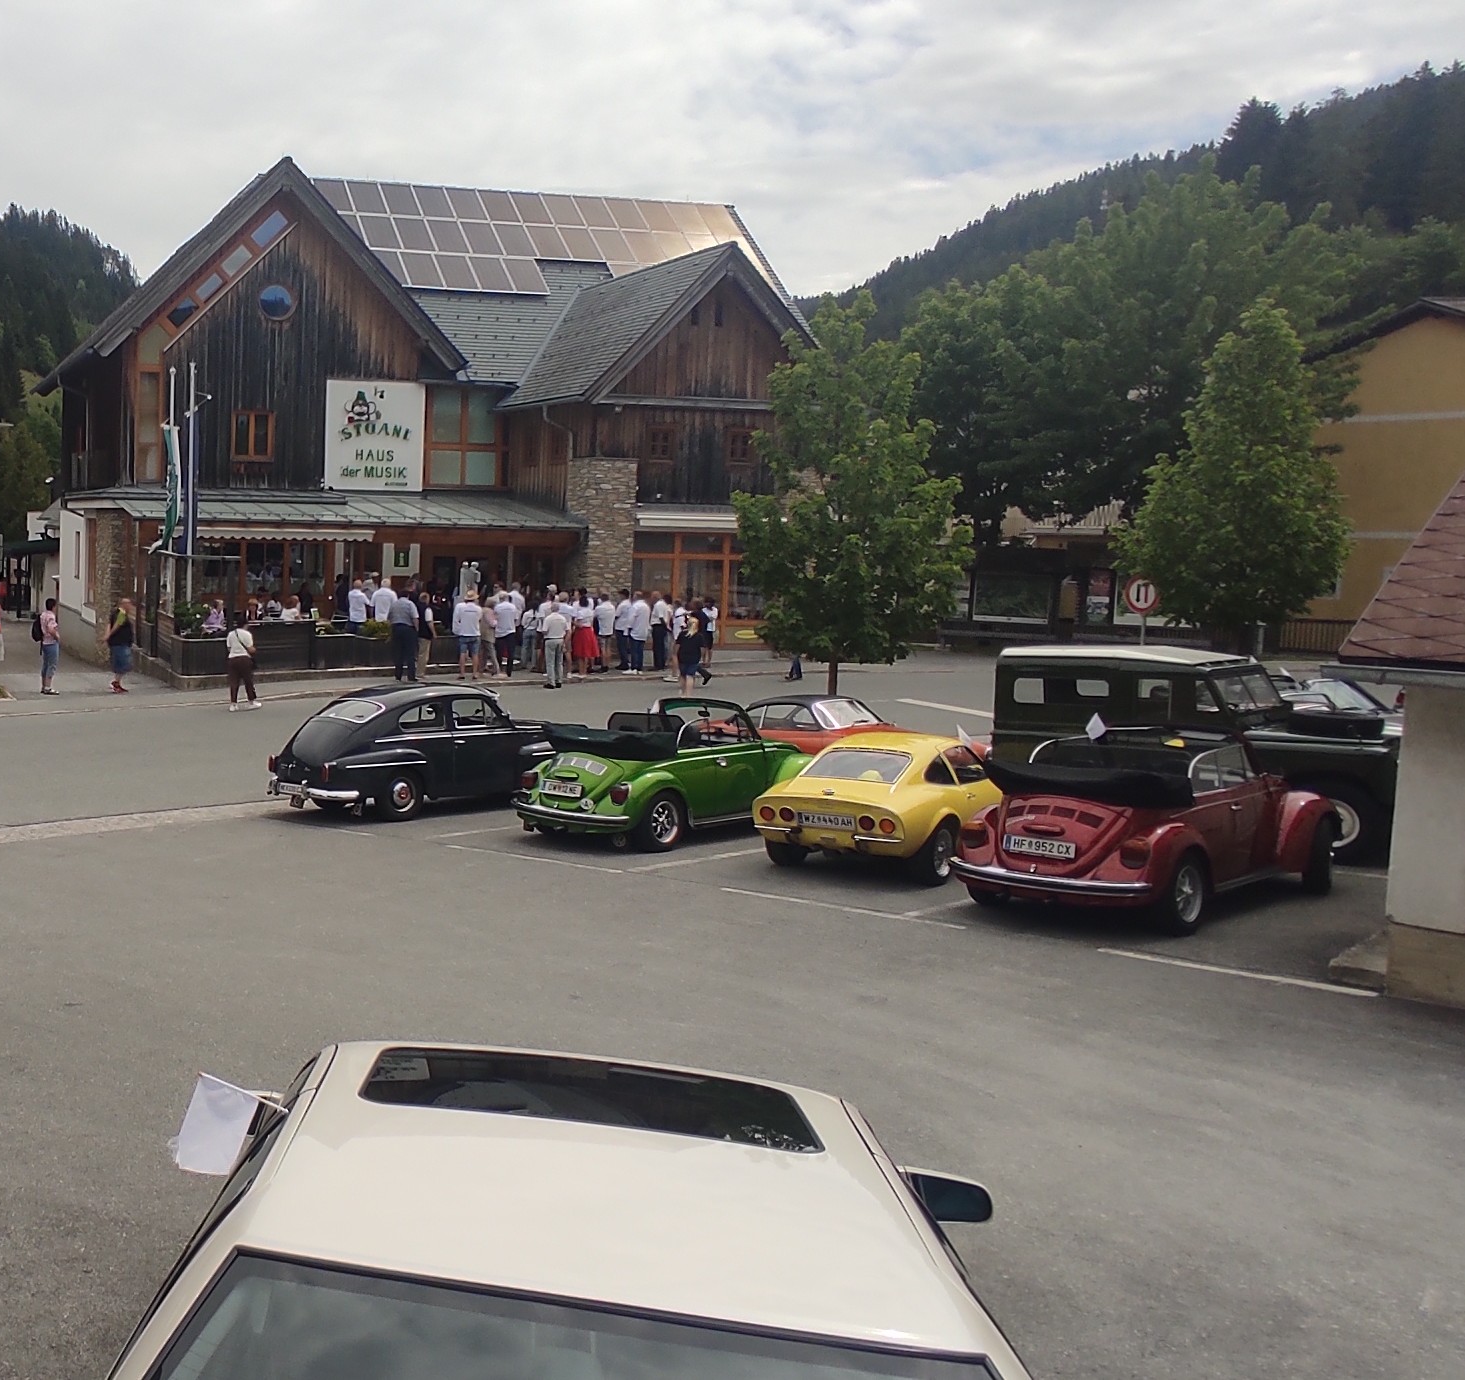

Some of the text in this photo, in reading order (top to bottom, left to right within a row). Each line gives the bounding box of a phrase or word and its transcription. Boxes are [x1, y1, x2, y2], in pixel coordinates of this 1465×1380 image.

[355, 449, 394, 461] HAUS
[342, 465, 407, 478] der MUSIK
[803, 814, 853, 827] WZ 440 AH
[1013, 838, 1072, 855] HF 952 CX
